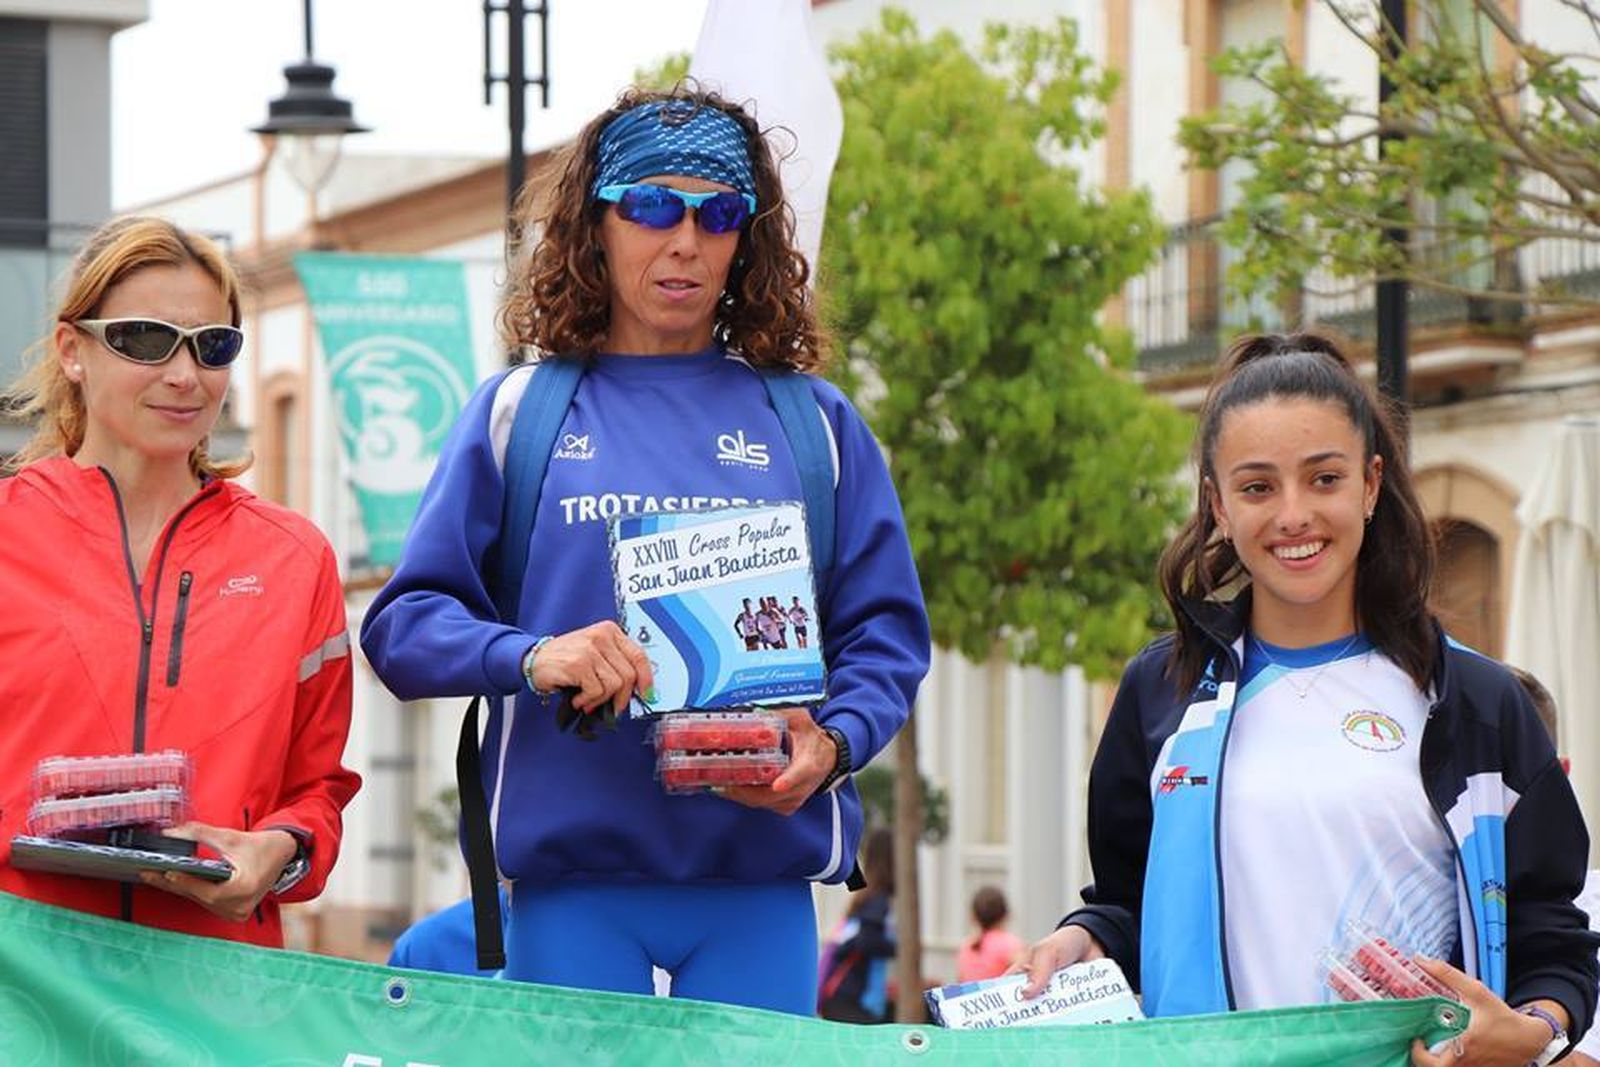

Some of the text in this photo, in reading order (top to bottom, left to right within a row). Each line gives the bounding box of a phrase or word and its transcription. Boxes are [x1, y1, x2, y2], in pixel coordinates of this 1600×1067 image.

[560, 493, 765, 524] TROTASIE
[633, 516, 791, 568] XXVIII Cross Popular
[629, 546, 801, 594] San Juan Bautista
[960, 990, 1007, 1018] XXVIII
[1059, 964, 1110, 989] Popular
[1001, 1004, 1045, 1026] Juan
[1041, 982, 1124, 1014] Bautista
